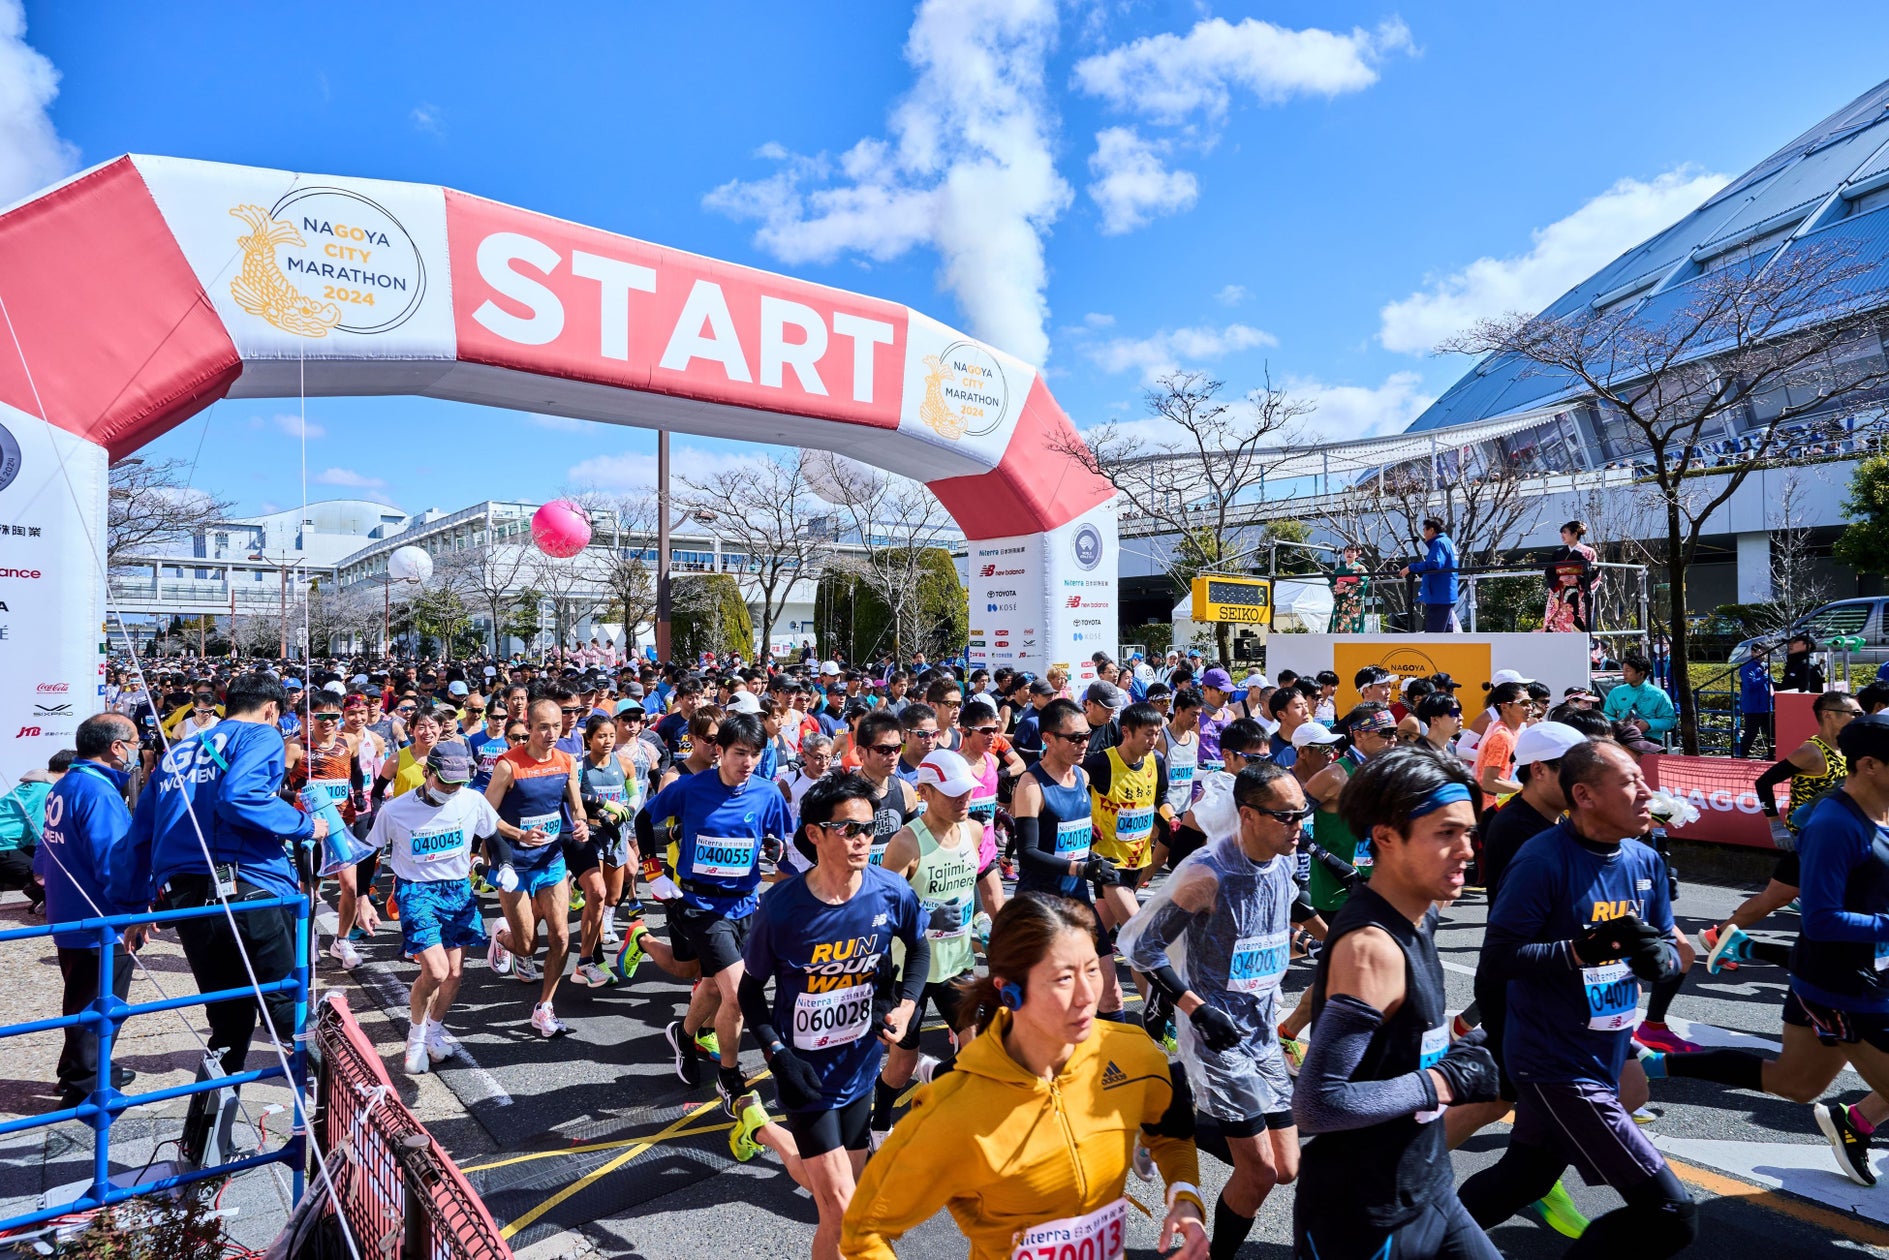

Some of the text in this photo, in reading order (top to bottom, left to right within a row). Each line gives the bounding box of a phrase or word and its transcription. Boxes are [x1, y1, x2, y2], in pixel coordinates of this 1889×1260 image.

[304, 217, 390, 247] NAGOYA
[324, 243, 371, 263] CITY
[288, 257, 406, 291] MARATHON
[323, 285, 375, 306] 2024
[472, 232, 893, 403] START
[954, 361, 993, 378] NAGOYA
[962, 377, 984, 390] CITY
[945, 387, 999, 407] MARATHON
[960, 405, 984, 417] 2024
[999, 602, 1017, 611] KOSÉ
[1220, 606, 1259, 621] SEIKO
[16, 726, 41, 738] JTB
[161, 732, 227, 774] GO
[159, 765, 216, 794] WOMEN
[1118, 814, 1152, 831] 040081
[412, 831, 462, 853] 040043
[698, 838, 723, 846] Niterra
[1058, 828, 1091, 849] 040160
[697, 845, 750, 865] 040055
[928, 859, 965, 883] Tajimi
[928, 876, 974, 893] Runners
[1591, 900, 1645, 922] RUN
[810, 934, 878, 964] RUN
[803, 953, 881, 975] YOUR
[807, 971, 875, 993] WAY
[1586, 971, 1617, 983] Niterra
[797, 998, 832, 1007] Niterra
[797, 998, 870, 1032] 060028
[1102, 1072, 1128, 1086] adidas
